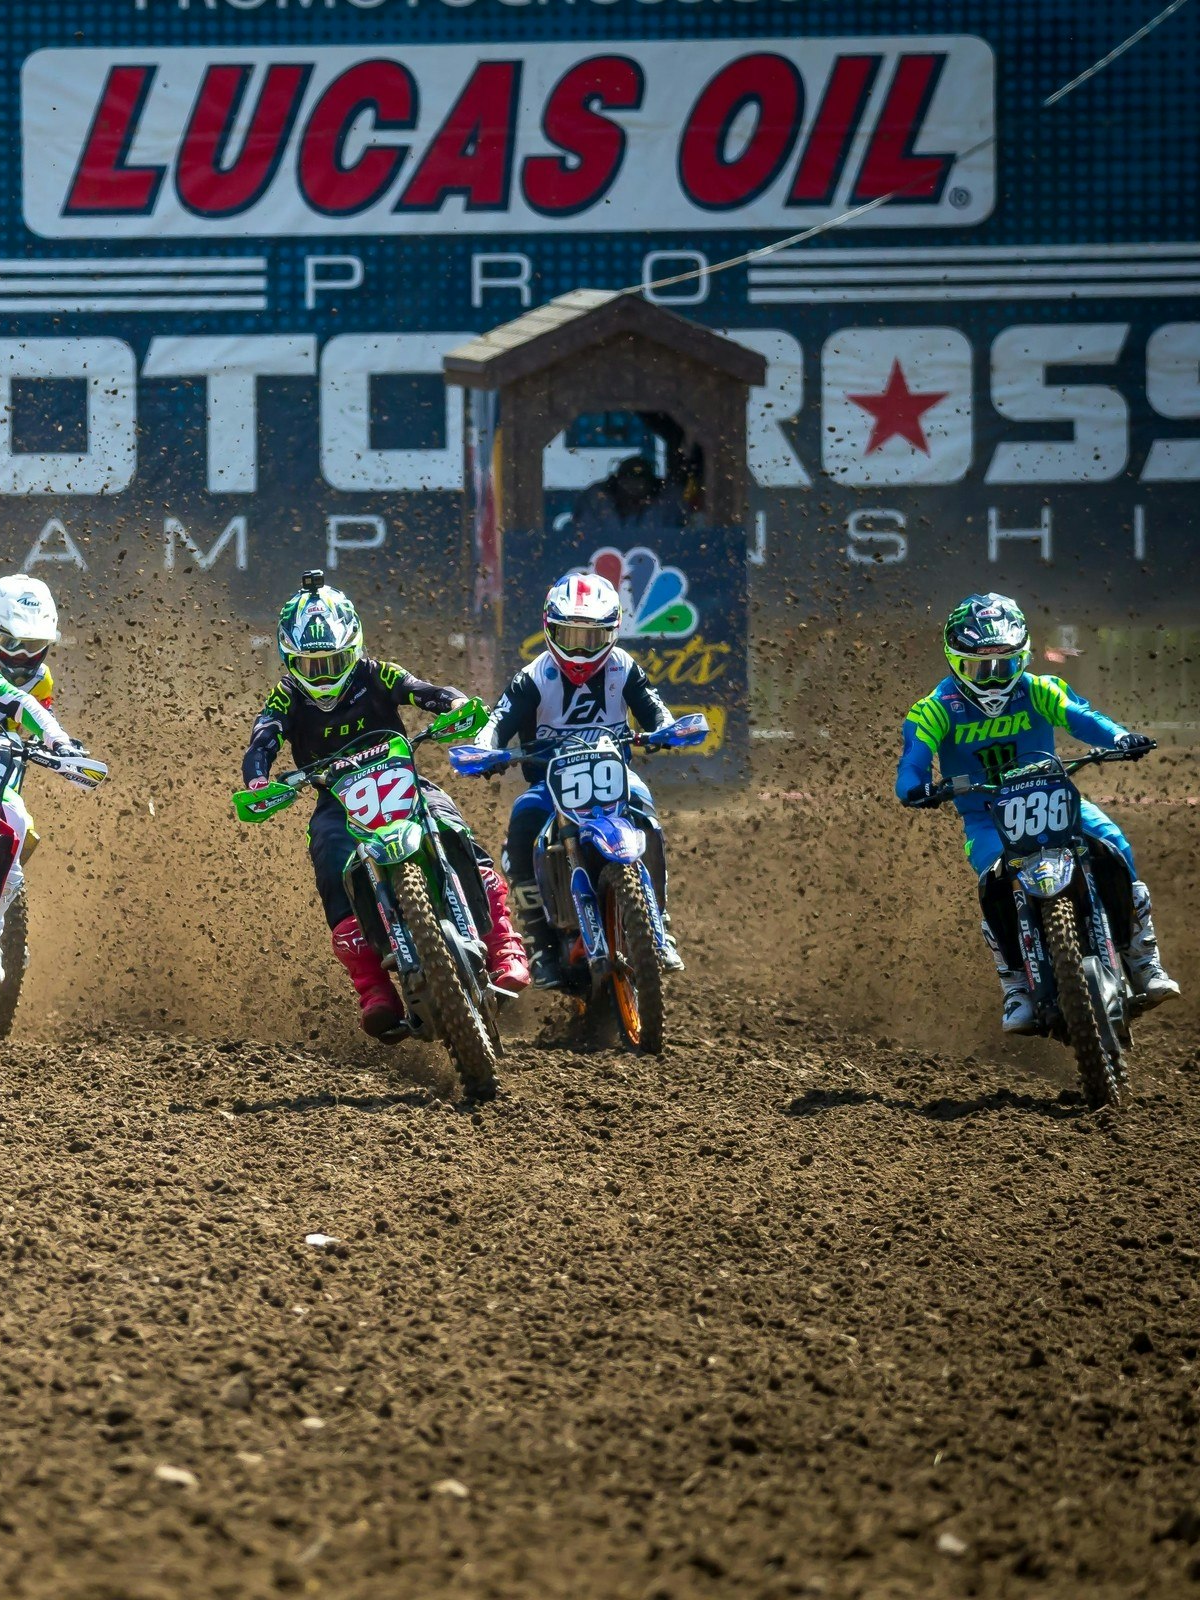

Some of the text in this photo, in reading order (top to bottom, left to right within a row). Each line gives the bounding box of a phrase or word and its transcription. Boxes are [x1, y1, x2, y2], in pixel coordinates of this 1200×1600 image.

[61, 52, 957, 219] LUCAS OIL
[305, 250, 710, 310] PRO
[324, 718, 365, 738] FOX
[955, 710, 1031, 745] THOR
[354, 763, 389, 782] LUCAS OIL
[567, 752, 601, 764] LUCAS OIL
[345, 768, 414, 825] 92
[561, 759, 624, 809] 59
[1011, 779, 1048, 792] LUCAS OIL
[1004, 788, 1071, 841] 936
[446, 886, 471, 942] DUNLOP
